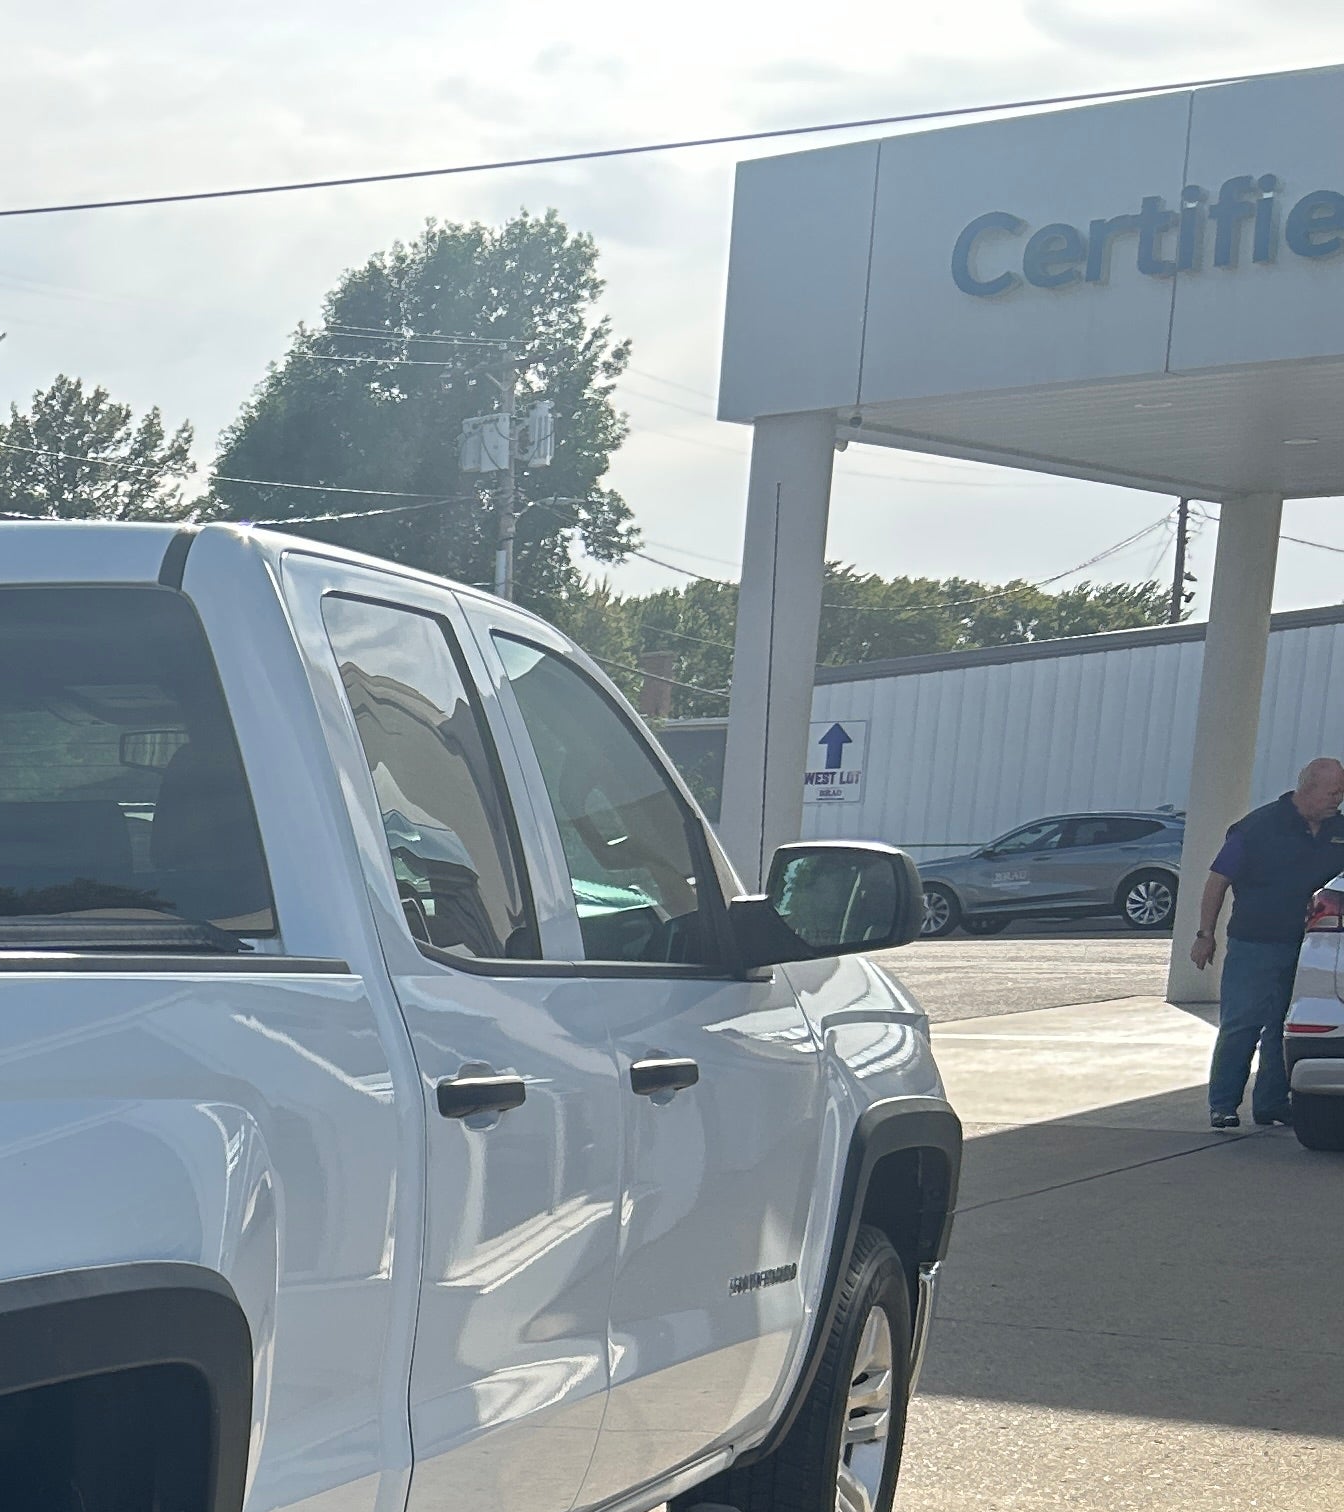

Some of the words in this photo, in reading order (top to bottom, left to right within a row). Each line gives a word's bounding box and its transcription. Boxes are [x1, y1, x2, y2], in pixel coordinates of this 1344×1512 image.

[951, 173, 1344, 297] Certifie
[804, 772, 836, 786] WEST
[839, 771, 861, 785] LOT
